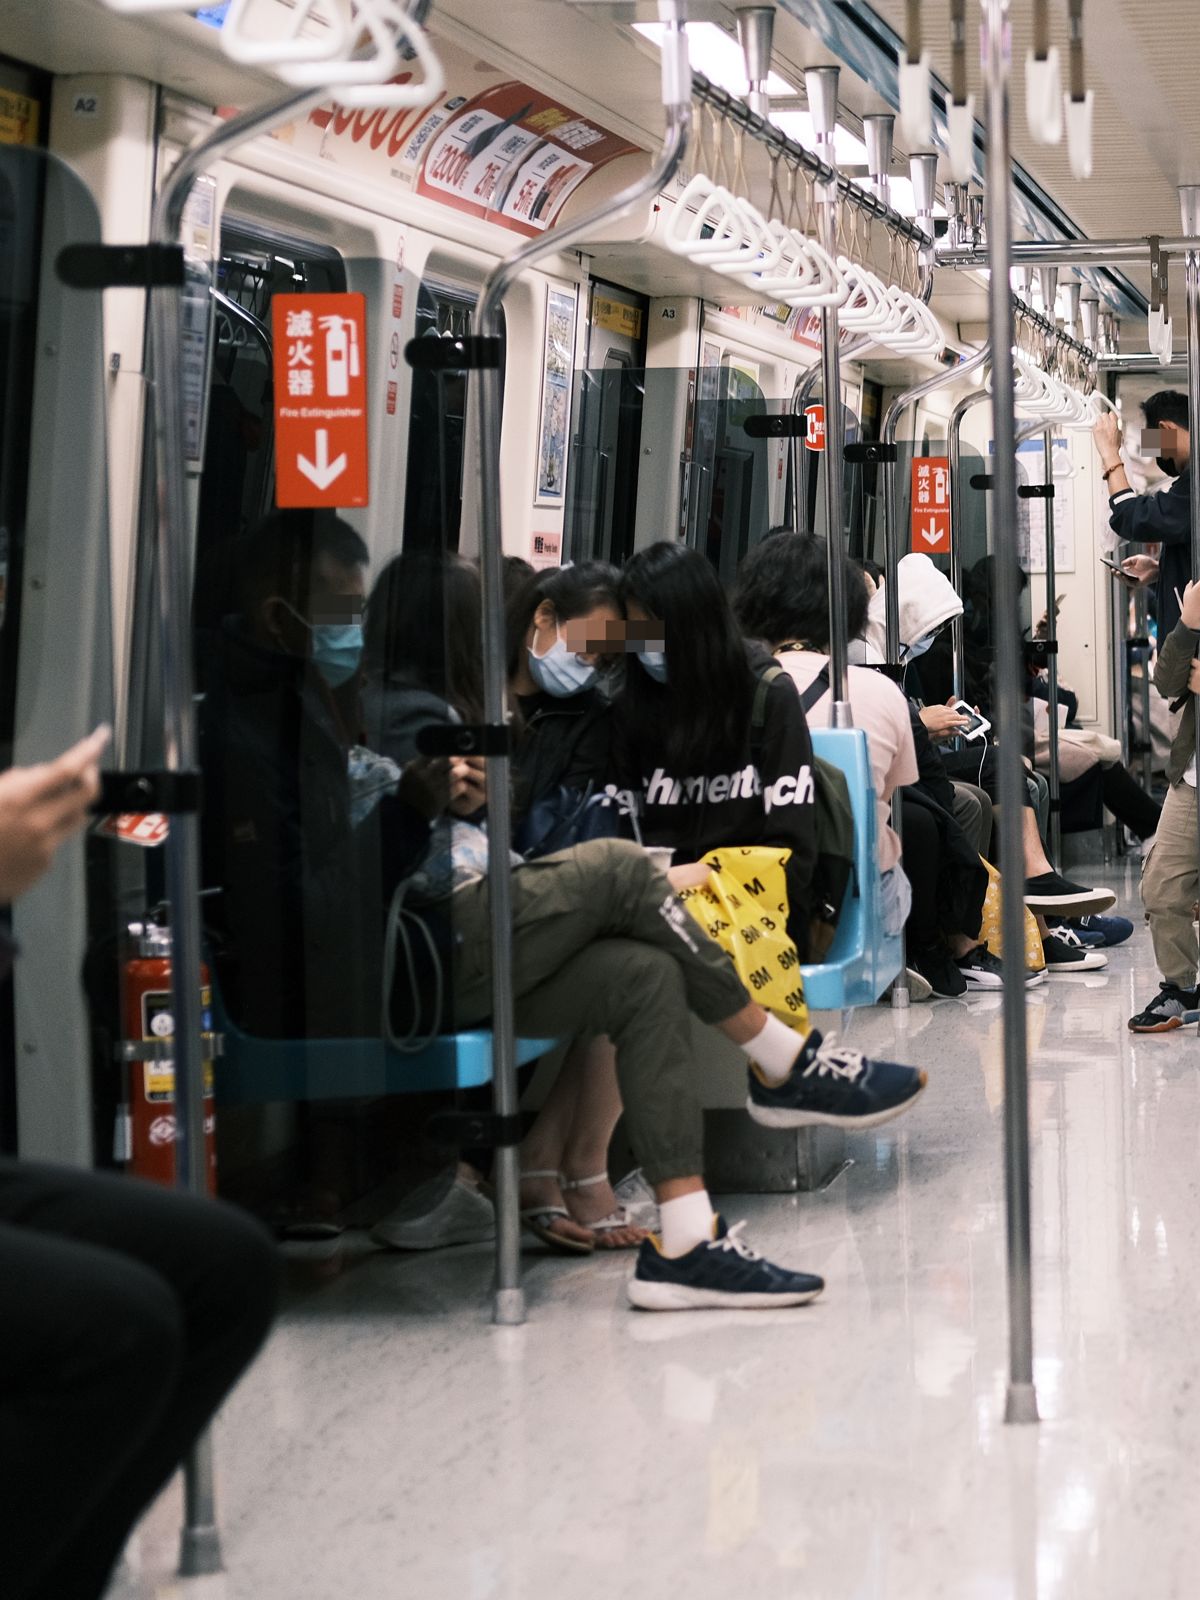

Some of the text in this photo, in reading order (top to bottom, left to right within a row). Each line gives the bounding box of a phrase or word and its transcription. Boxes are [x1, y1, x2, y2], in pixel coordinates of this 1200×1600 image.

[75, 97, 97, 112] A2
[662, 308, 676, 319] A3
[285, 309, 315, 396] 滅火器
[279, 406, 362, 419] Fire Extinguisher
[749, 966, 773, 990] 8M
